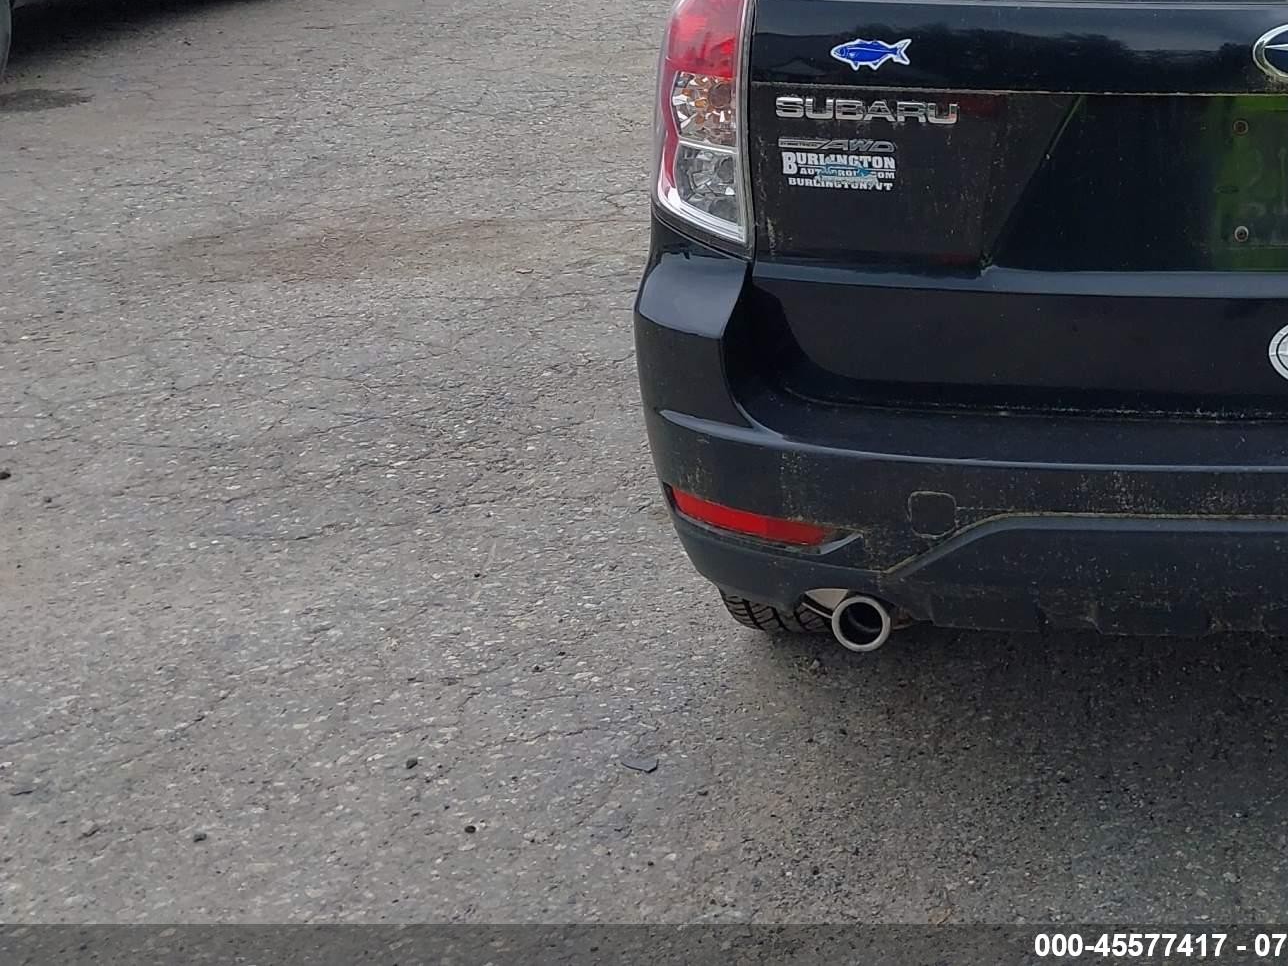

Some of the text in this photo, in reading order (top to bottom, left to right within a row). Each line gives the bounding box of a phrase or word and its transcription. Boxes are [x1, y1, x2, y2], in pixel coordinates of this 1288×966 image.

[775, 96, 961, 125] SUBARU
[821, 138, 896, 153] AWD
[781, 151, 896, 175] BURLINGTON
